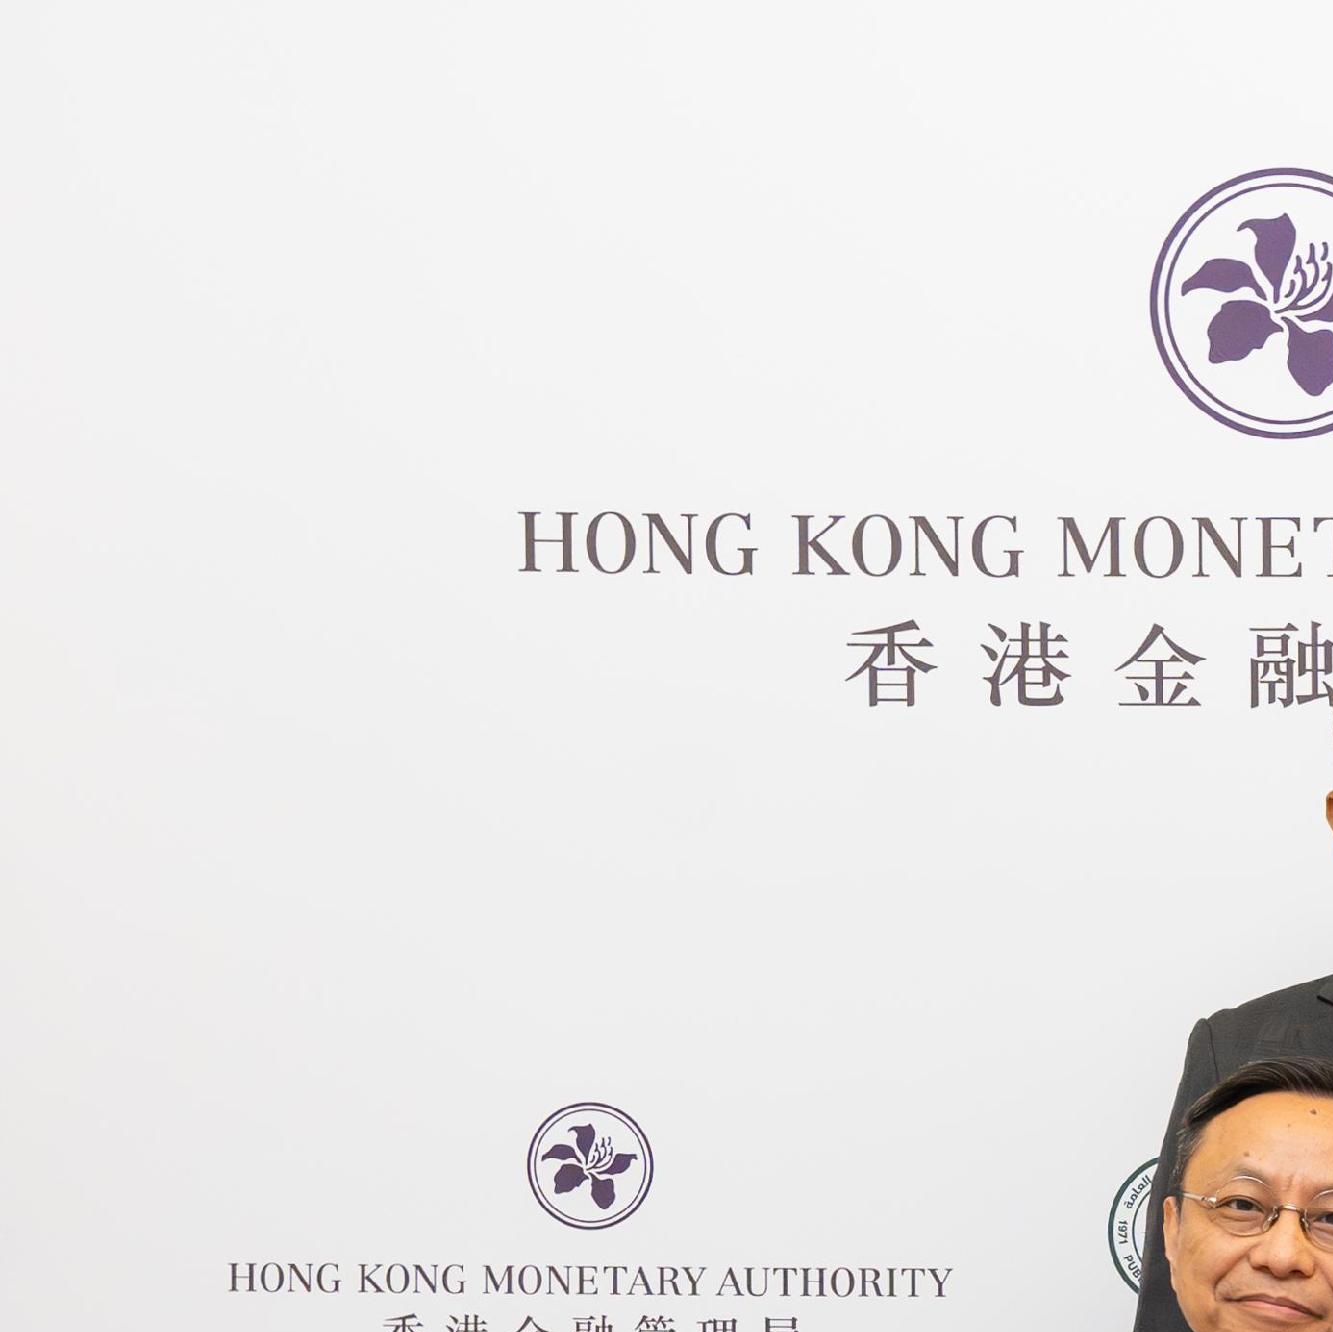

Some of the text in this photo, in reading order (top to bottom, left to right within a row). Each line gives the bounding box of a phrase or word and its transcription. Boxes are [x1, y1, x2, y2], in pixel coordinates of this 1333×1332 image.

[518, 511, 758, 576] HONG
[792, 514, 1024, 578] KONG
[1118, 1220, 1128, 1244] 1971
[229, 1263, 953, 1297] HONG KONG MONETARY AUTHORITY
